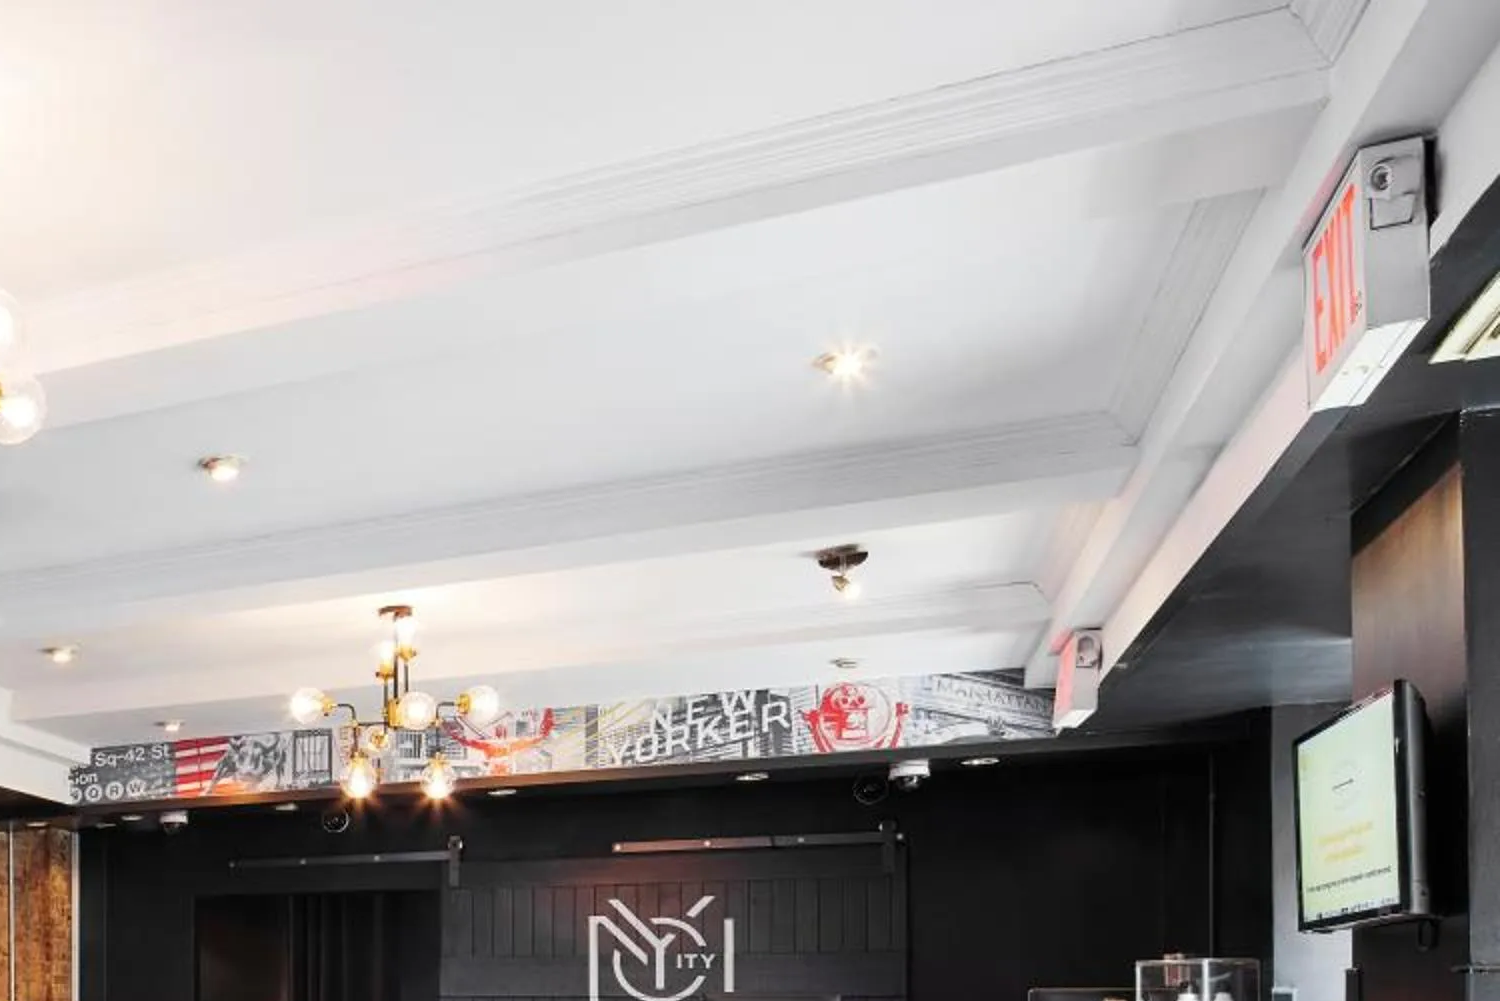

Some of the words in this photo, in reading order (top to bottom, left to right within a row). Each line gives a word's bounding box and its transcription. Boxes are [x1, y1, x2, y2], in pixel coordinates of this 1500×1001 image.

[1312, 184, 1360, 375] EXIT
[607, 699, 791, 767] YORKER
[652, 689, 757, 737] NEW
